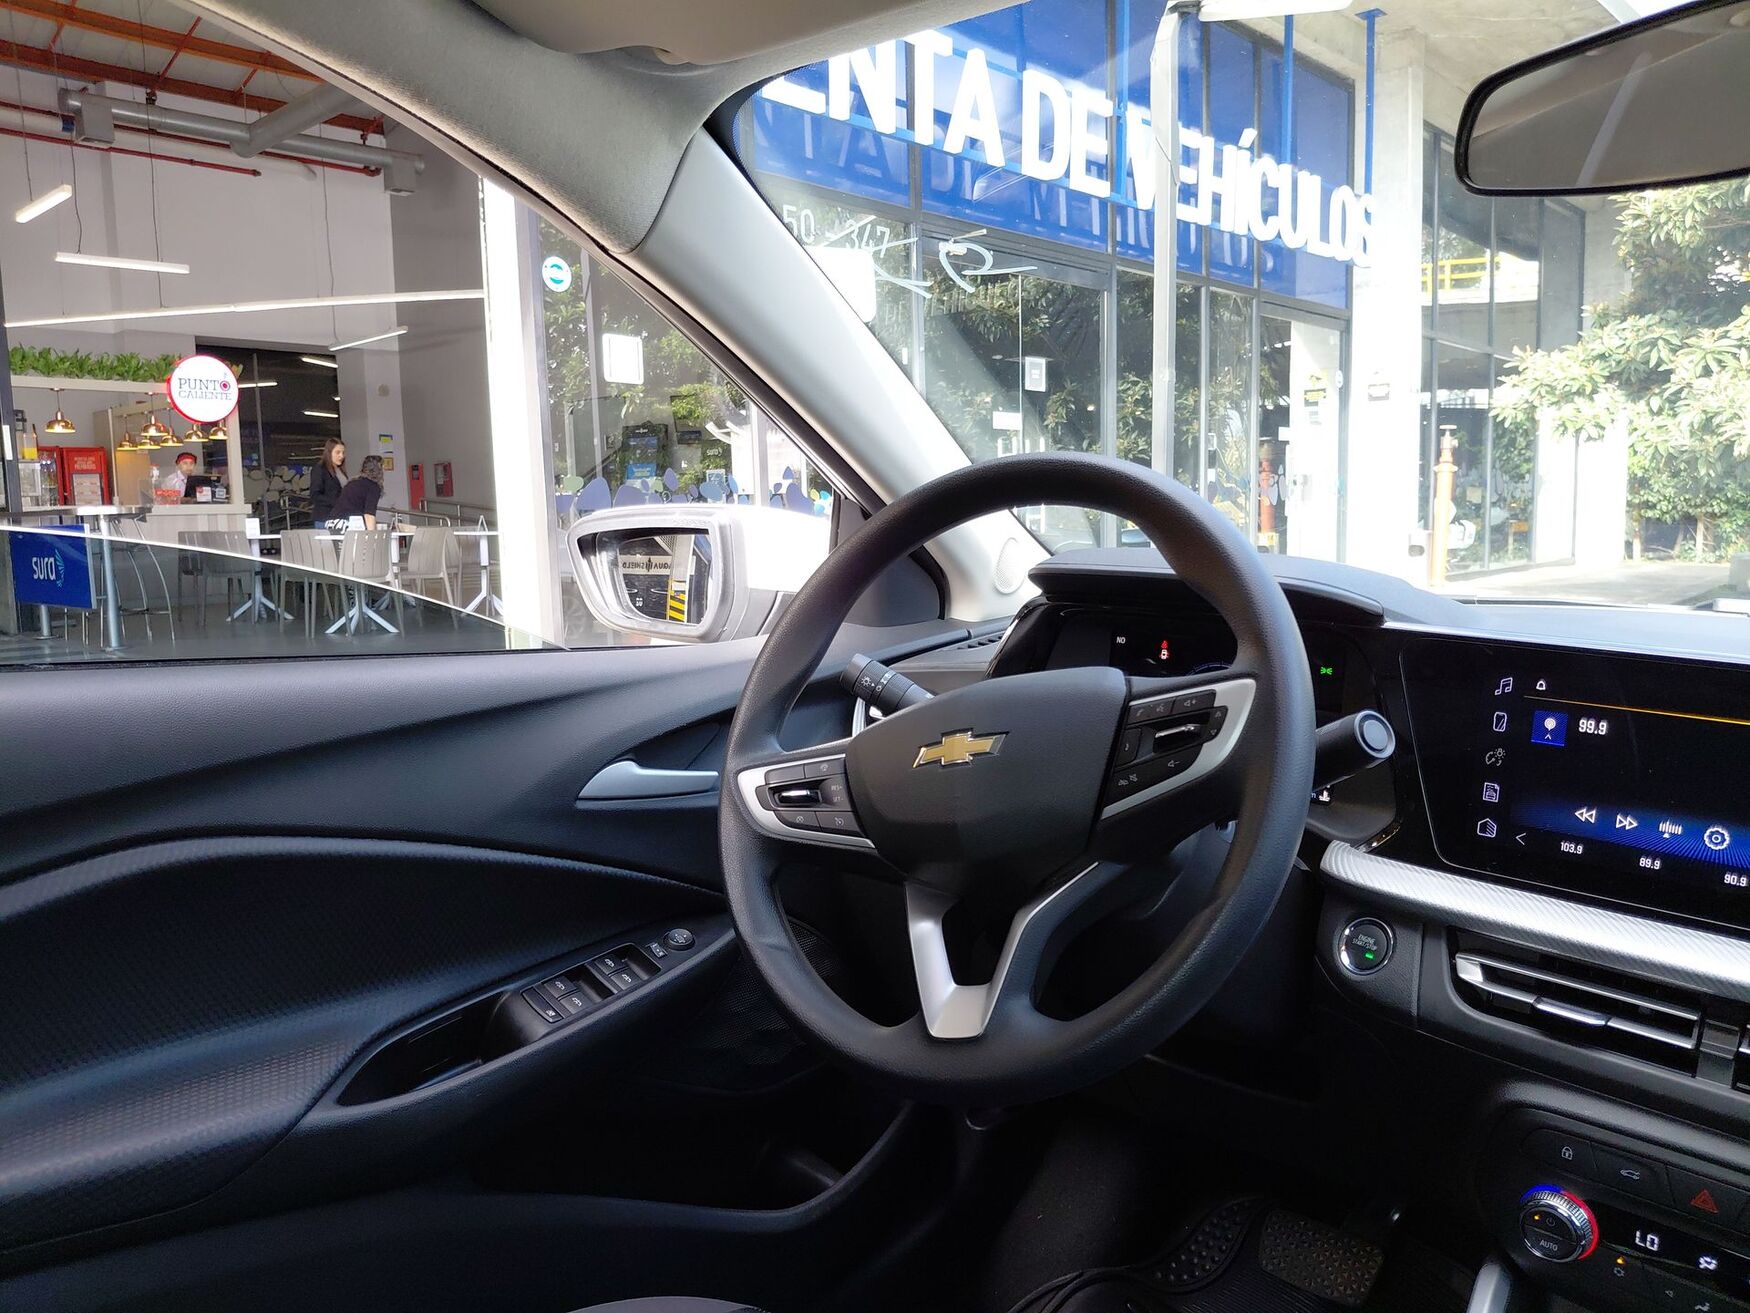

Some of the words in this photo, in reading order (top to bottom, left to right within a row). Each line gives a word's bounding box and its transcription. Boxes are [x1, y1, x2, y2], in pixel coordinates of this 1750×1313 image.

[1021, 67, 1114, 198] DE
[178, 378, 230, 391] PUNTO
[178, 390, 232, 400] CALIENTE
[32, 556, 56, 580] sura
[1578, 718, 1607, 735] 99.9
[1560, 841, 1583, 855] 103.9
[1639, 856, 1661, 870] 89.9
[1723, 873, 1748, 887] 90.9
[1539, 1239, 1558, 1251] AUTO
[1635, 1230, 1659, 1251] LO
